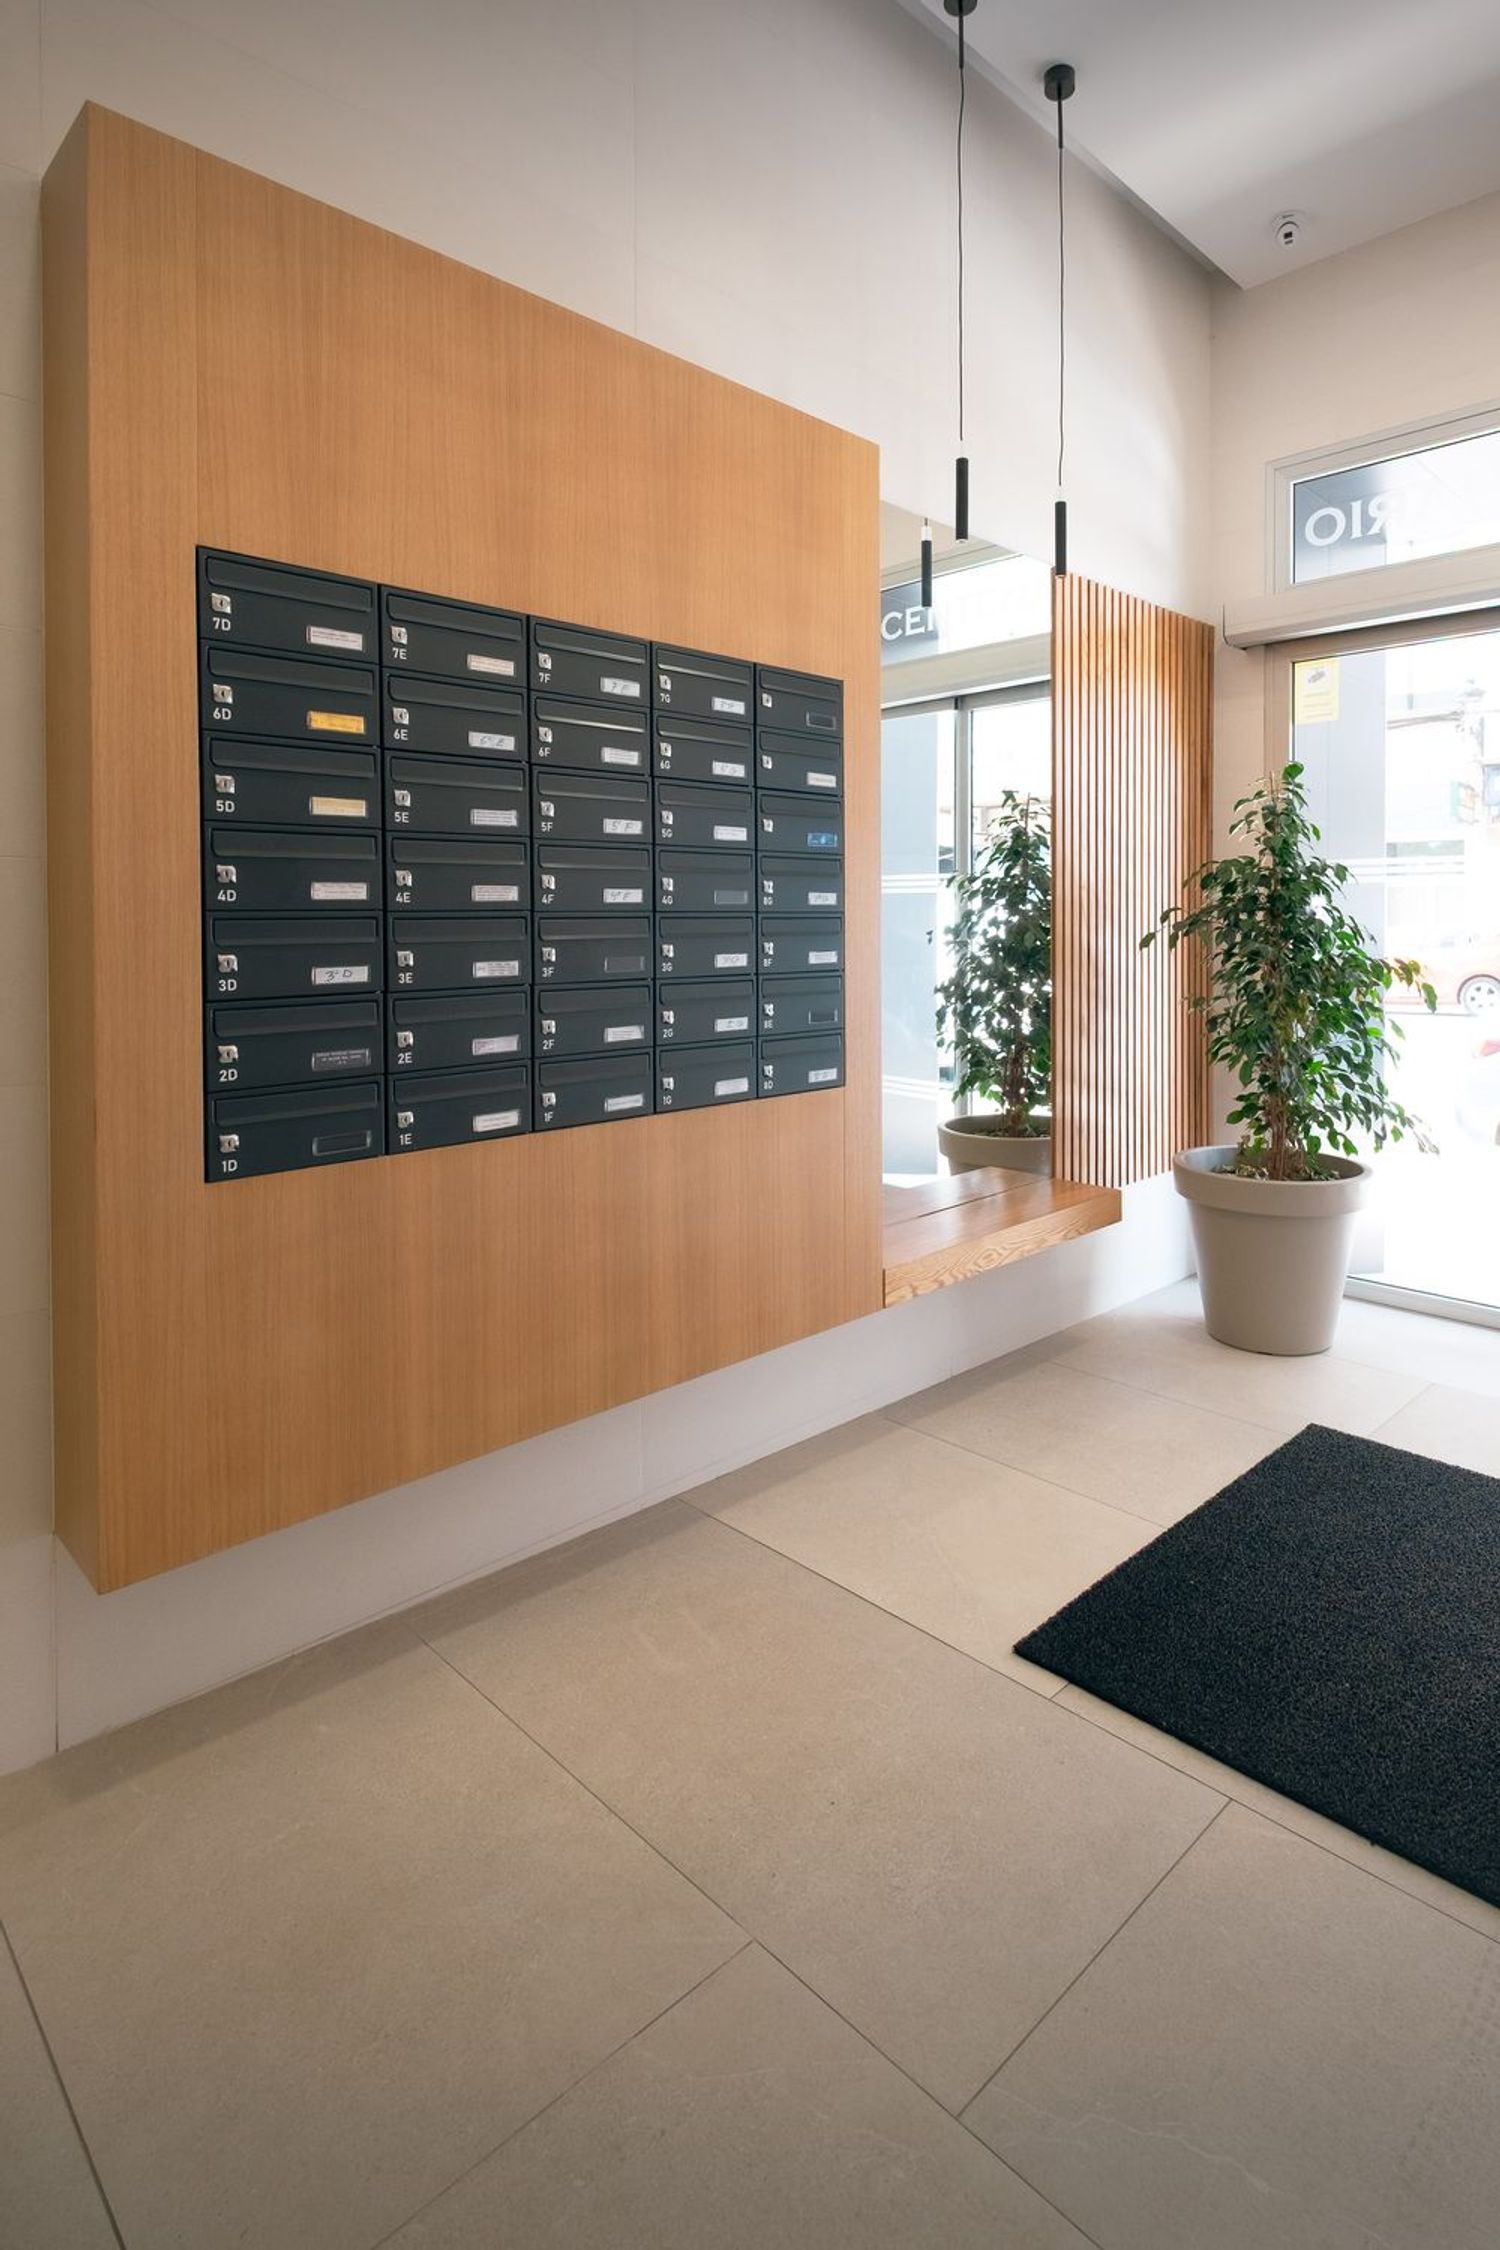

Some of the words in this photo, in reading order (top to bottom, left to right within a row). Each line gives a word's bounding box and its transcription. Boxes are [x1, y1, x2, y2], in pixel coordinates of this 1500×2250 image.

[213, 617, 231, 632] 7D
[393, 647, 407, 660] 7E
[539, 673, 551, 683] 7F
[213, 708, 231, 720] 6D
[394, 729, 408, 740] 6E
[539, 747, 550, 757] 6F
[216, 800, 235, 812] 5D
[395, 812, 409, 823] 5E
[541, 822, 553, 832] 5F
[218, 890, 236, 901] 4D
[396, 892, 410, 902] 4E
[542, 894, 554, 903] 4F
[399, 972, 412, 983] 3E
[543, 967, 554, 977] 3F
[219, 979, 237, 991] 3D
[543, 1039, 554, 1049] 2F
[398, 1052, 412, 1064] 2E
[220, 1069, 237, 1082] 2D
[544, 1112, 553, 1122] 1F
[400, 1133, 412, 1145] 1E
[222, 1160, 237, 1172] 1D
